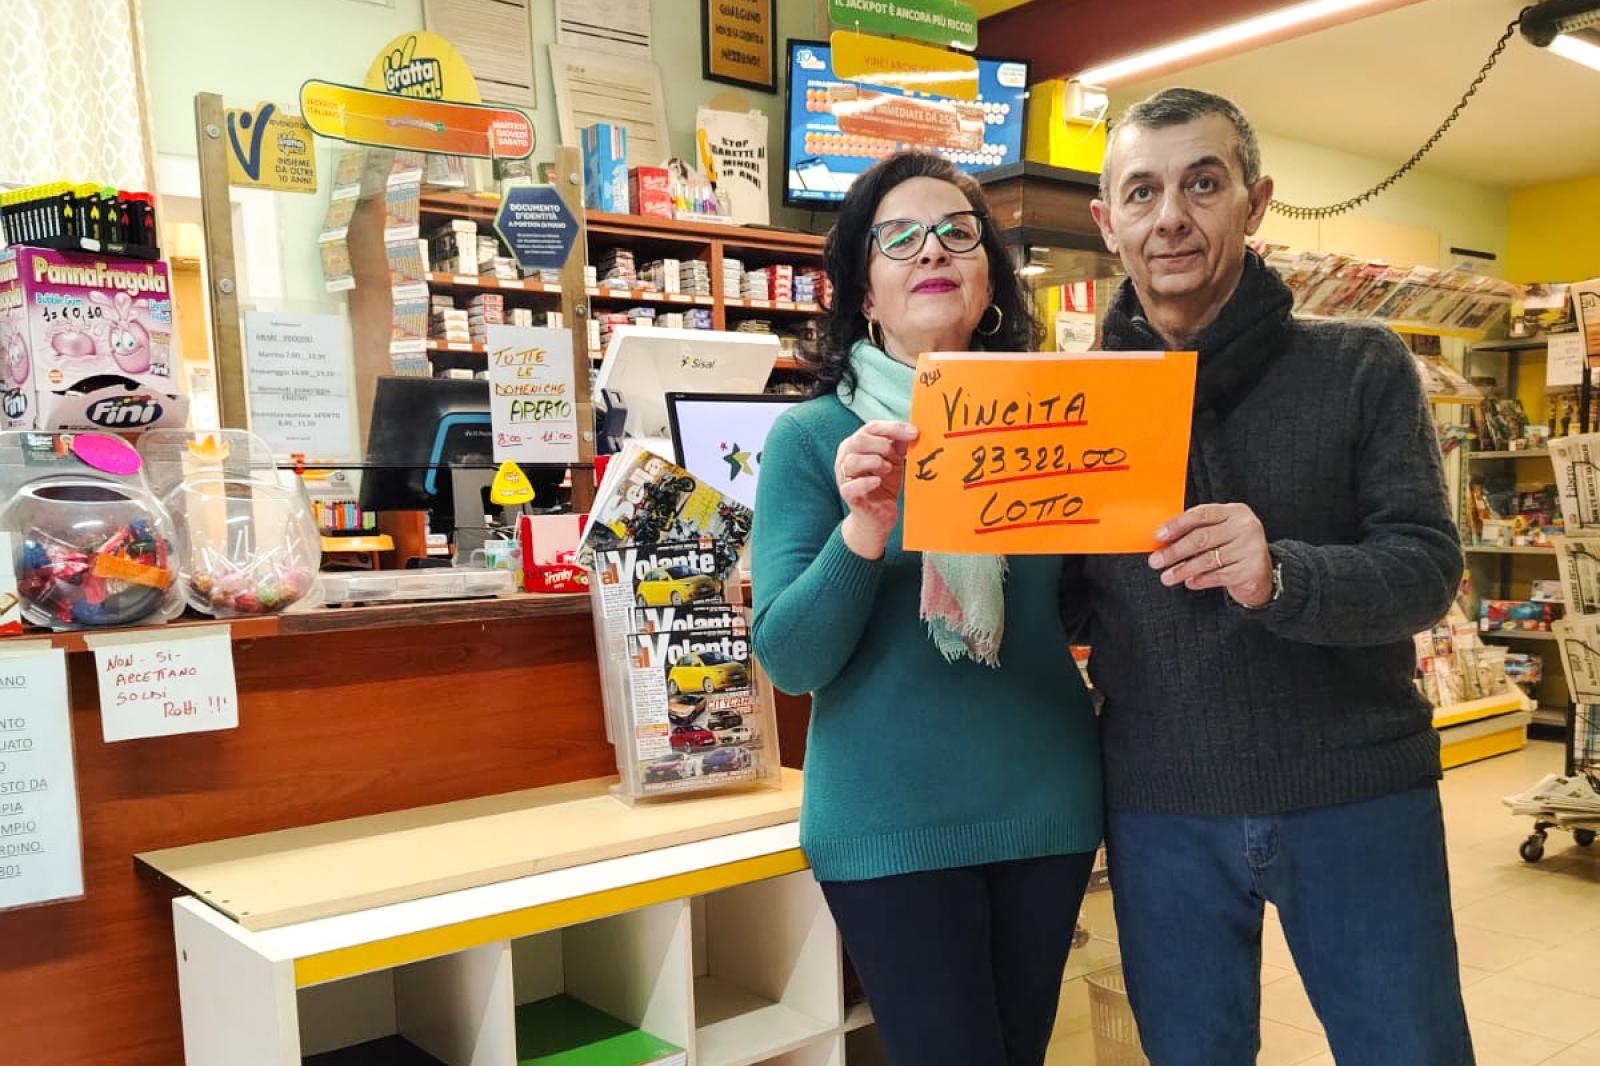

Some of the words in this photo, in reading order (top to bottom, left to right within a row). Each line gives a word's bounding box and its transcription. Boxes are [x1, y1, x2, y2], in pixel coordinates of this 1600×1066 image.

[846, 0, 888, 14] JACKPOT
[896, 7, 931, 23] ANCORA
[386, 60, 433, 91] Gratta
[722, 137, 749, 148] STOP
[278, 157, 311, 168] INSIEME
[723, 159, 760, 174] MINORI
[274, 164, 288, 174] DA
[290, 166, 314, 176] OLTRE
[291, 176, 313, 185] ANNI
[509, 203, 561, 213] DOCUMENTO
[691, 359, 716, 370] Sisal
[516, 366, 534, 378] LE
[495, 383, 566, 396] DOMENICHE
[91, 399, 158, 425] Fini
[510, 400, 572, 421] APERTO
[979, 492, 1084, 526] LOTTO
[607, 549, 716, 583] Volante
[639, 633, 748, 667] Volante
[106, 654, 133, 672] NON
[30, 779, 49, 792] DA
[0, 821, 37, 835] MPIO
